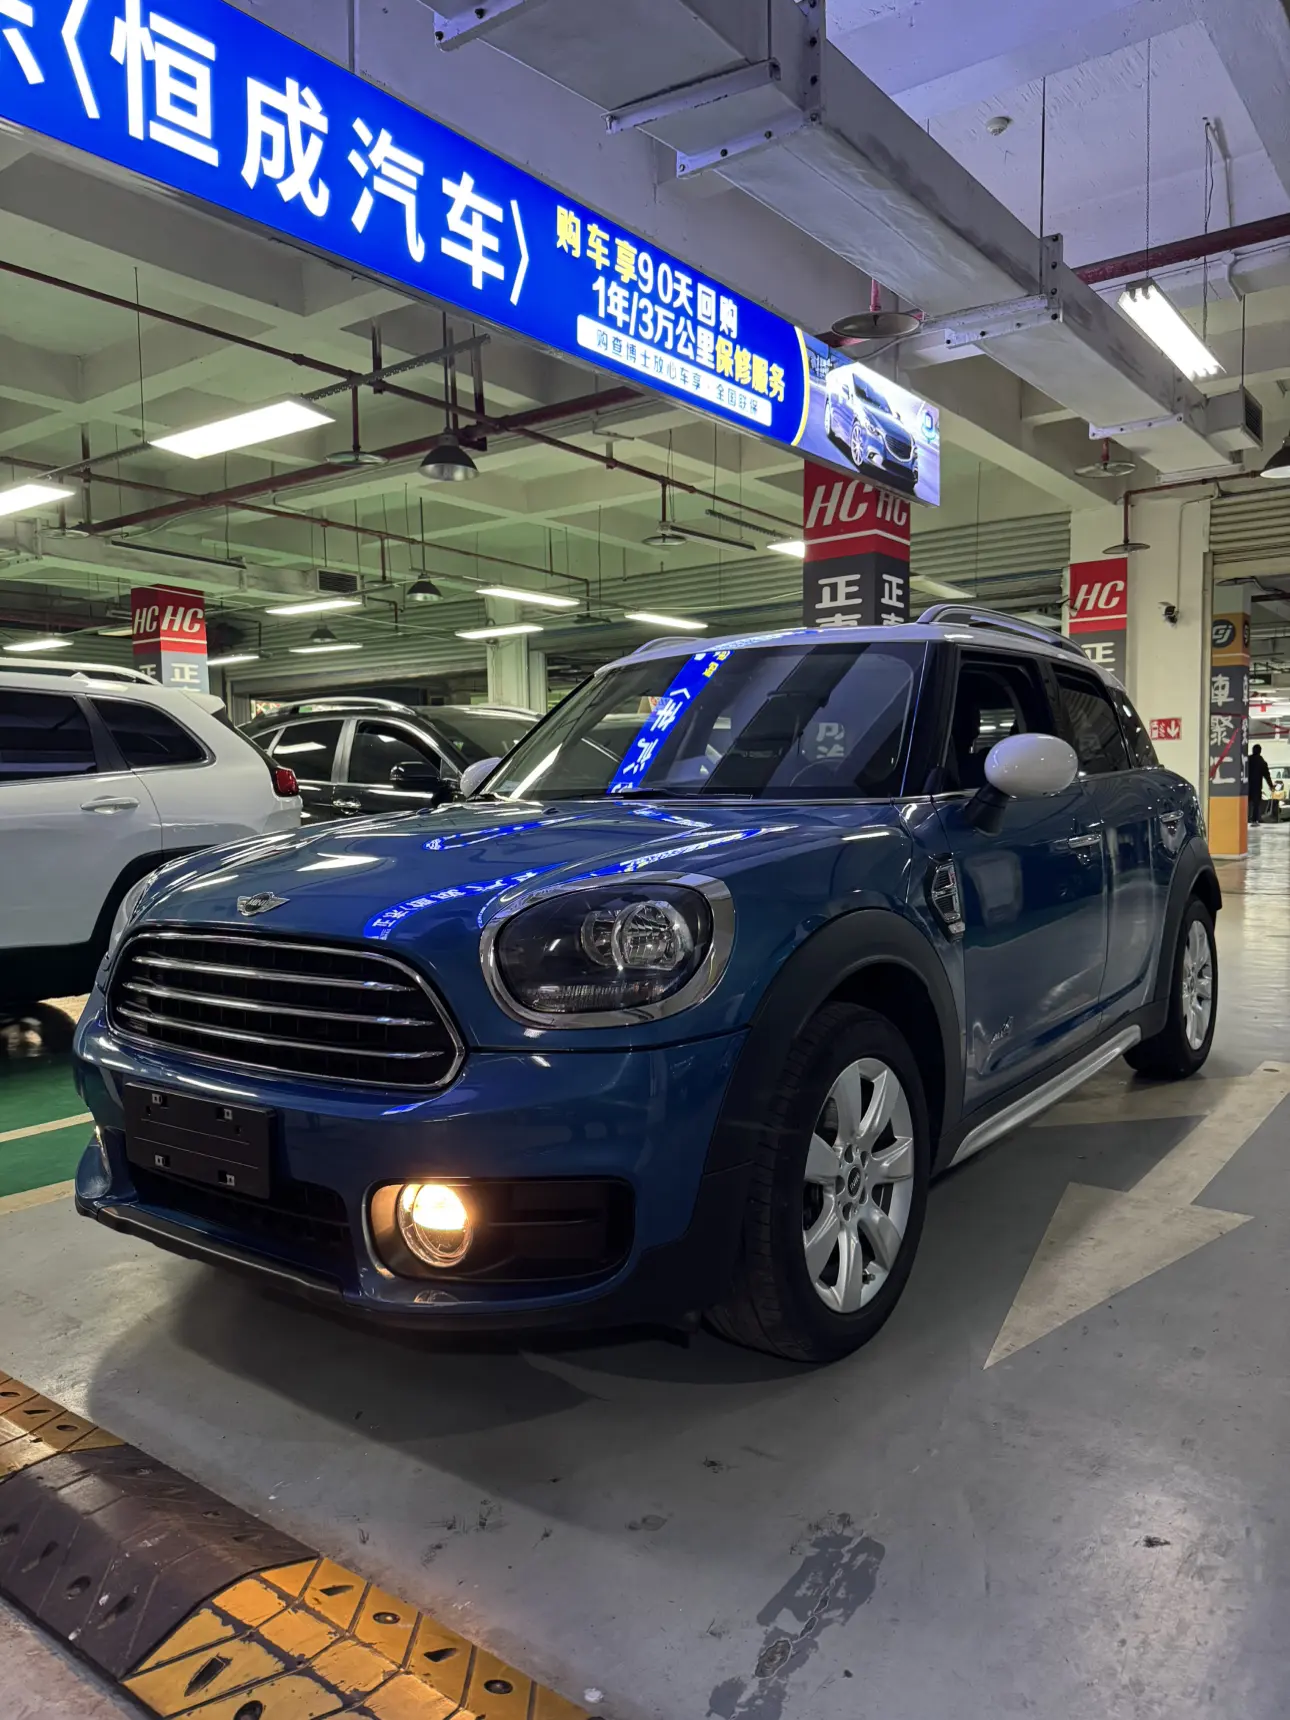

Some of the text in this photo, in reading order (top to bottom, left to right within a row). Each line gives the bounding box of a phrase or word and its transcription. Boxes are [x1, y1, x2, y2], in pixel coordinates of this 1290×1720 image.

[556, 205, 738, 340] 购车享90天回购
[592, 275, 786, 403] 1年/3万公里保修服务
[805, 479, 873, 528] HC
[134, 605, 159, 634] HC
[161, 605, 204, 633] HC
[1069, 580, 1125, 617] HC
